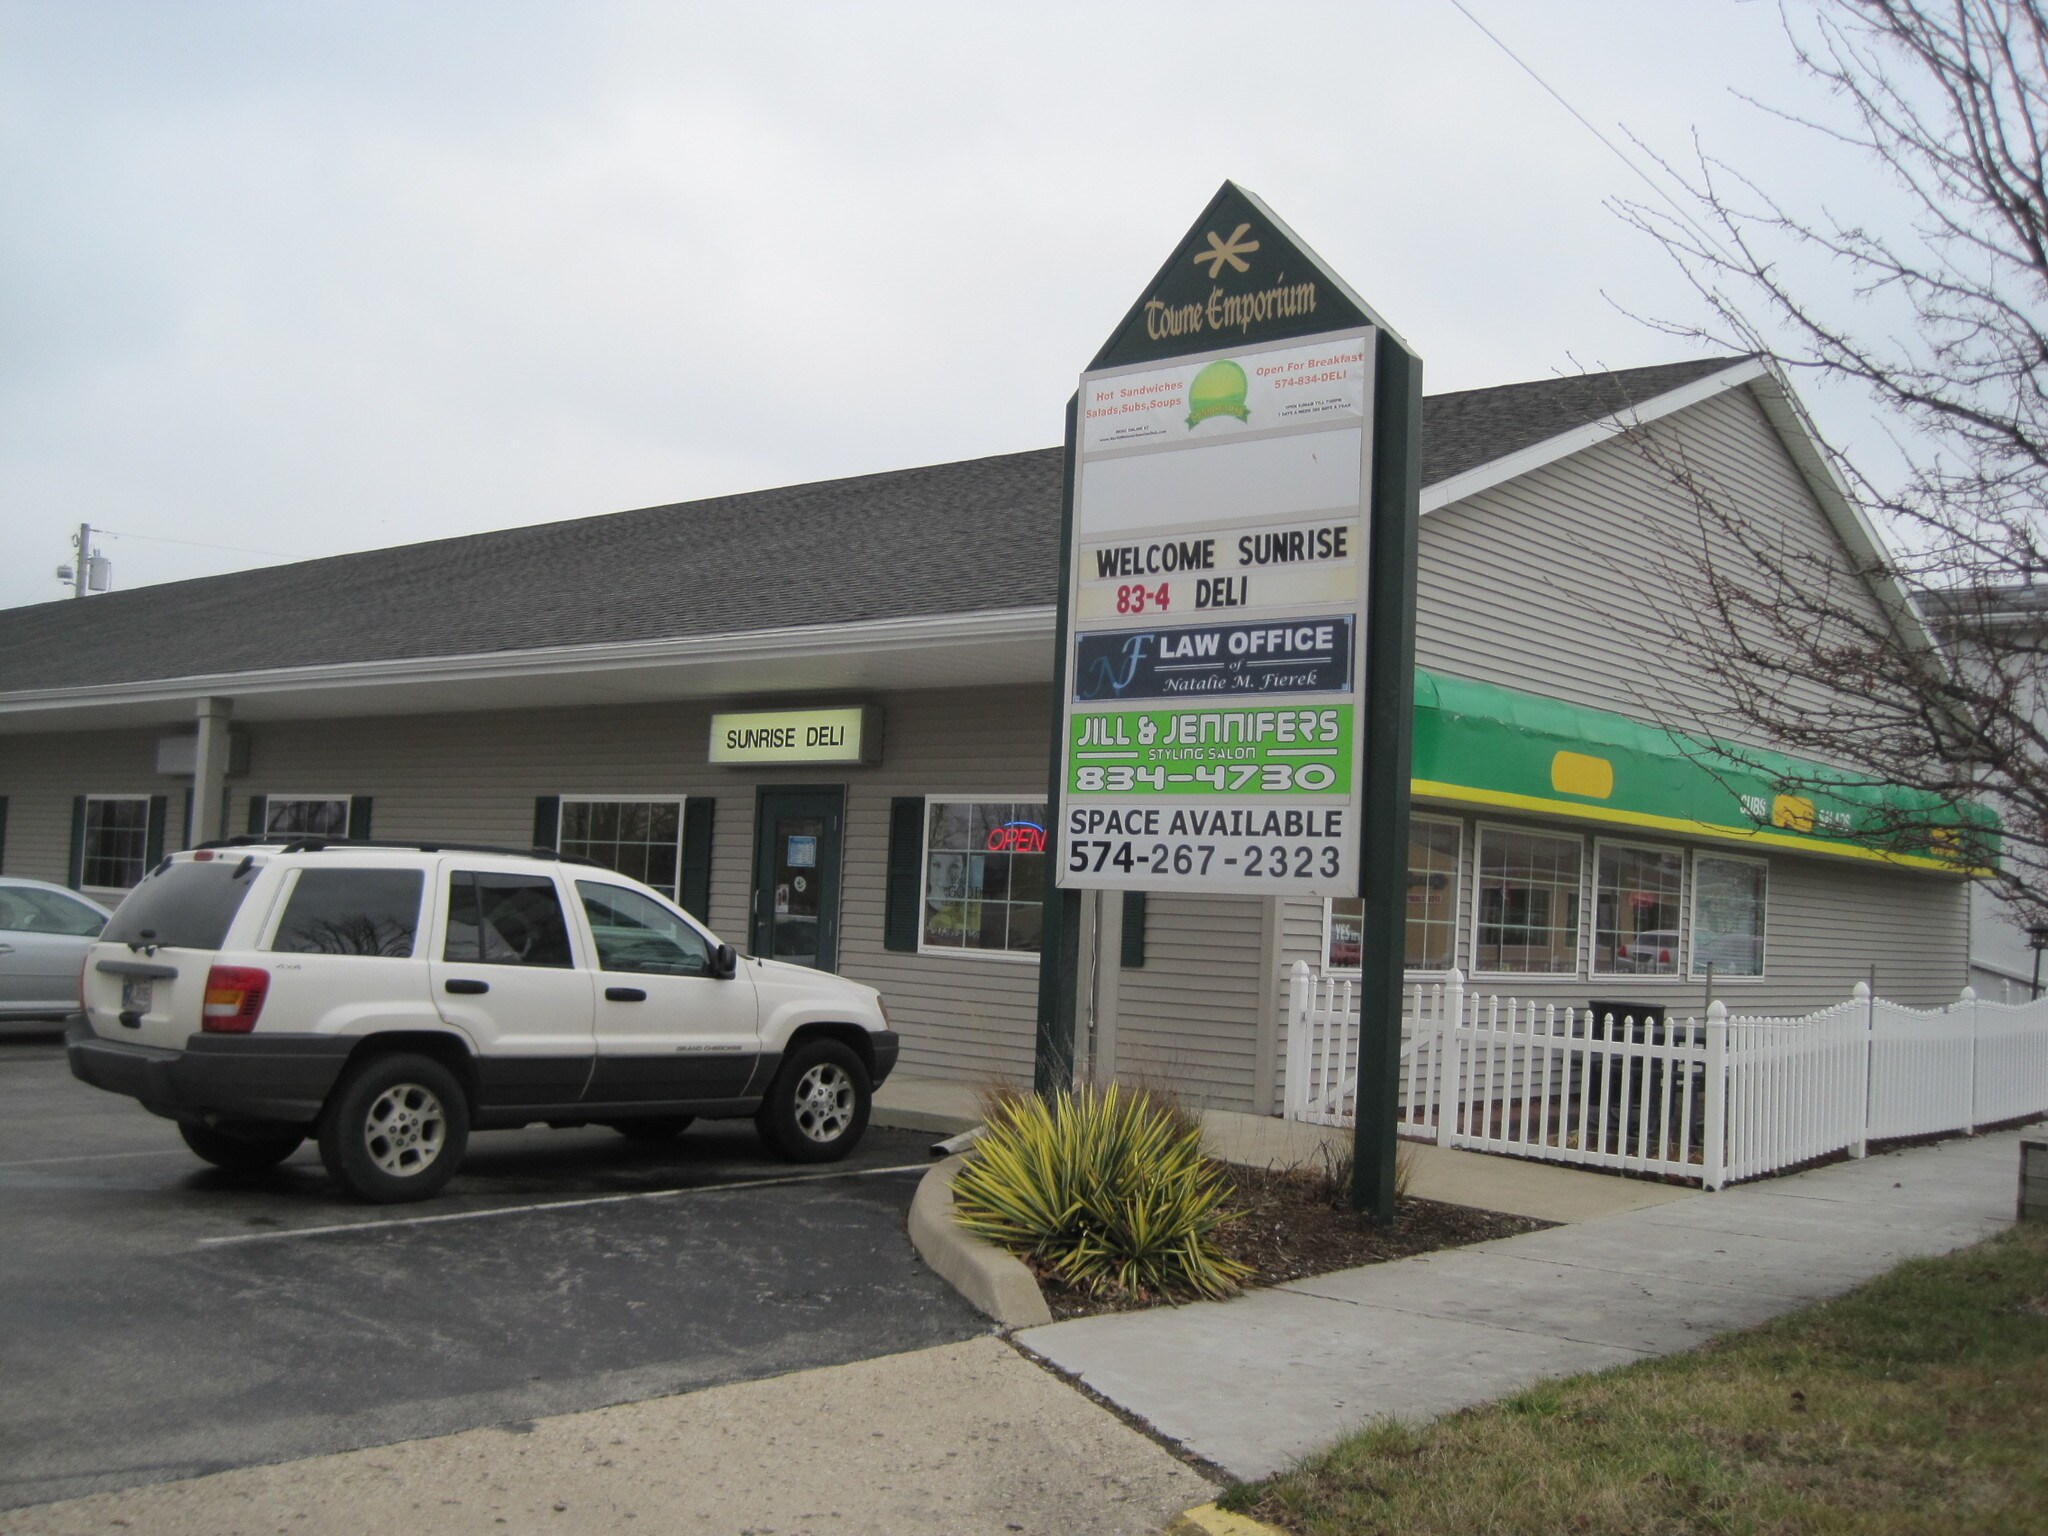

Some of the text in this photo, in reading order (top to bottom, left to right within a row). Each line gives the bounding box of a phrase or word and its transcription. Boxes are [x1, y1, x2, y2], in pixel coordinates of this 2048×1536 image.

[1145, 272, 1316, 340] Towne Emporium
[1256, 352, 1364, 377] Open For Breakfast
[1096, 381, 1183, 402] Hot Sandwiches
[1274, 370, 1347, 389] 574-834-DELI
[1097, 526, 1348, 578] WELCOME SUNRISE
[1116, 575, 1248, 614] 83-4 DELI
[1160, 626, 1334, 658] LAW OFFICE
[1228, 658, 1243, 672] of
[1163, 669, 1318, 692] Natalie M. Fierek
[726, 726, 845, 750] SUNRISE DELI
[1077, 709, 1339, 747] JILL & JENNIFERS
[1148, 746, 1256, 761] STYLING SALON
[1075, 763, 1337, 791] 834-4730
[1070, 809, 1342, 838] SPACE AVAILABLE
[987, 827, 1047, 852] OPEN
